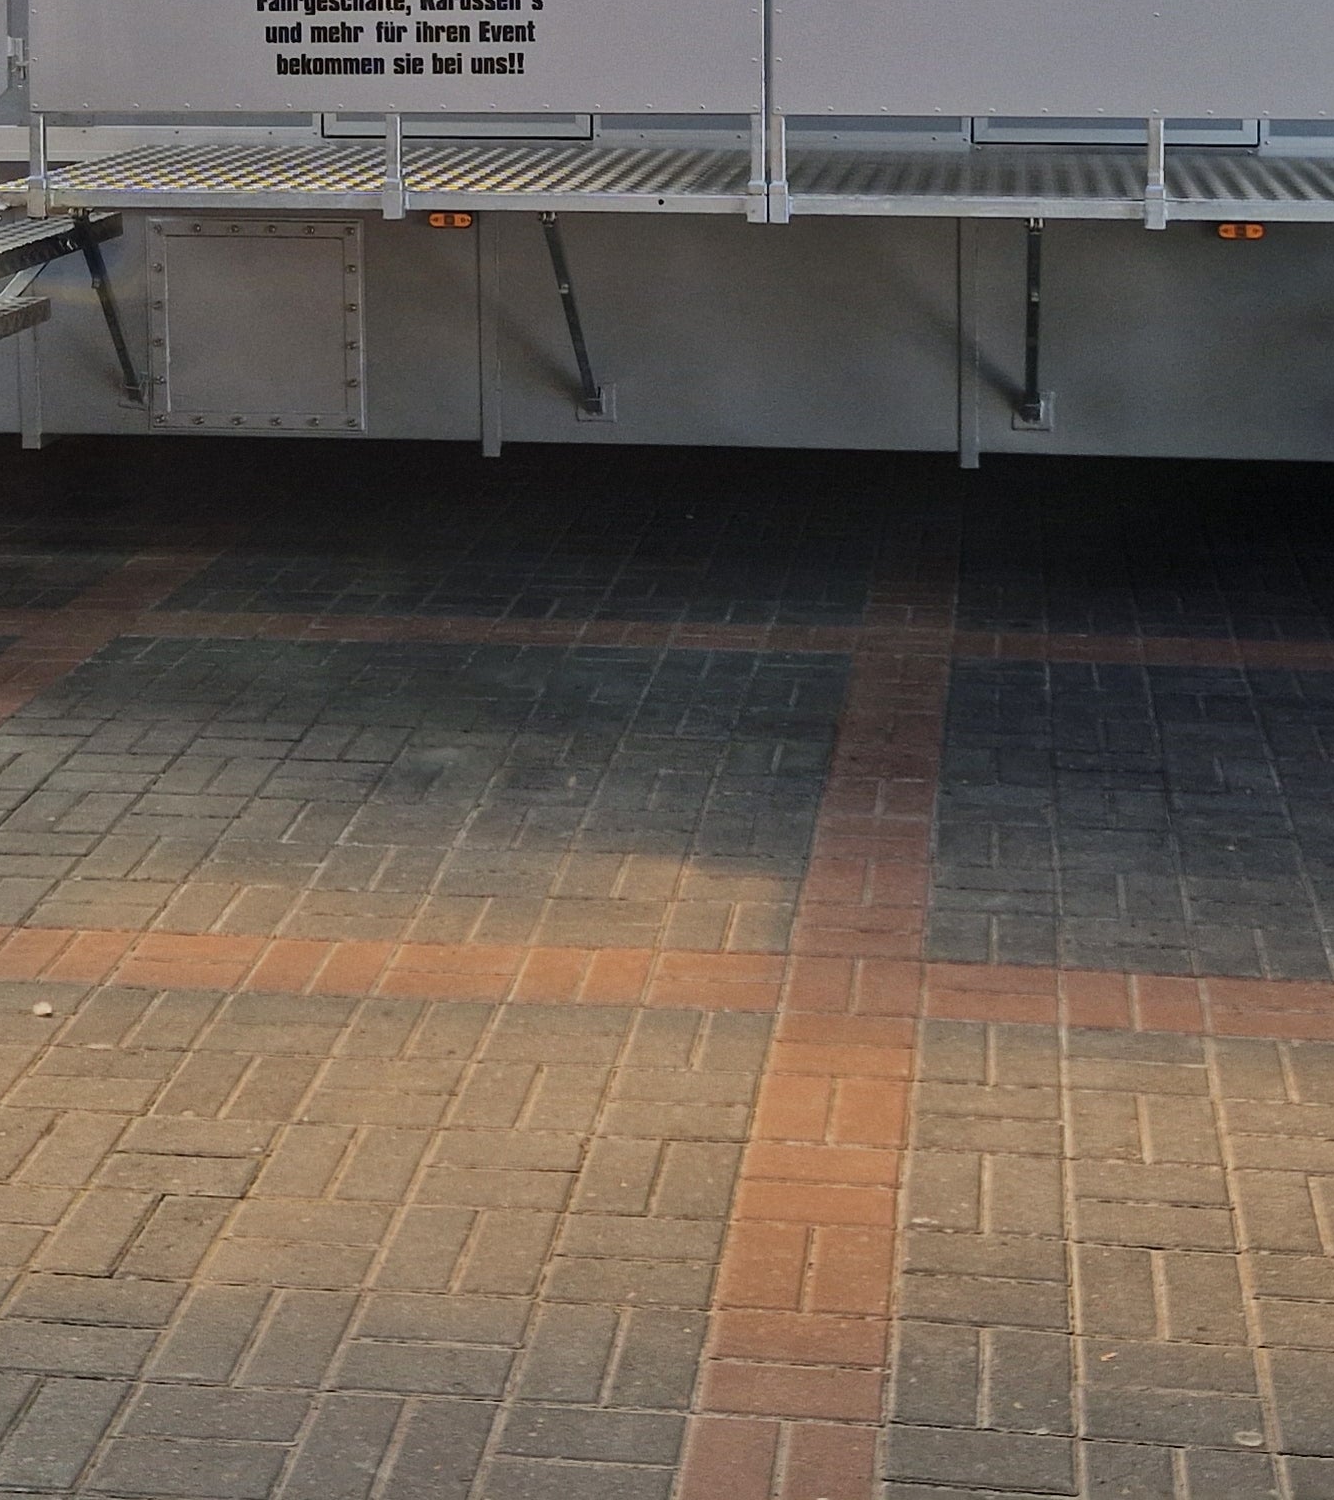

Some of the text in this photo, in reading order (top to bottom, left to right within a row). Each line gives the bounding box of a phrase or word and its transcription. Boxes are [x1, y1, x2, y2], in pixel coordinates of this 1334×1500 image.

[265, 20, 536, 43] und mehr für ihren Event
[276, 52, 525, 76] bekommen sie bei uns!!
